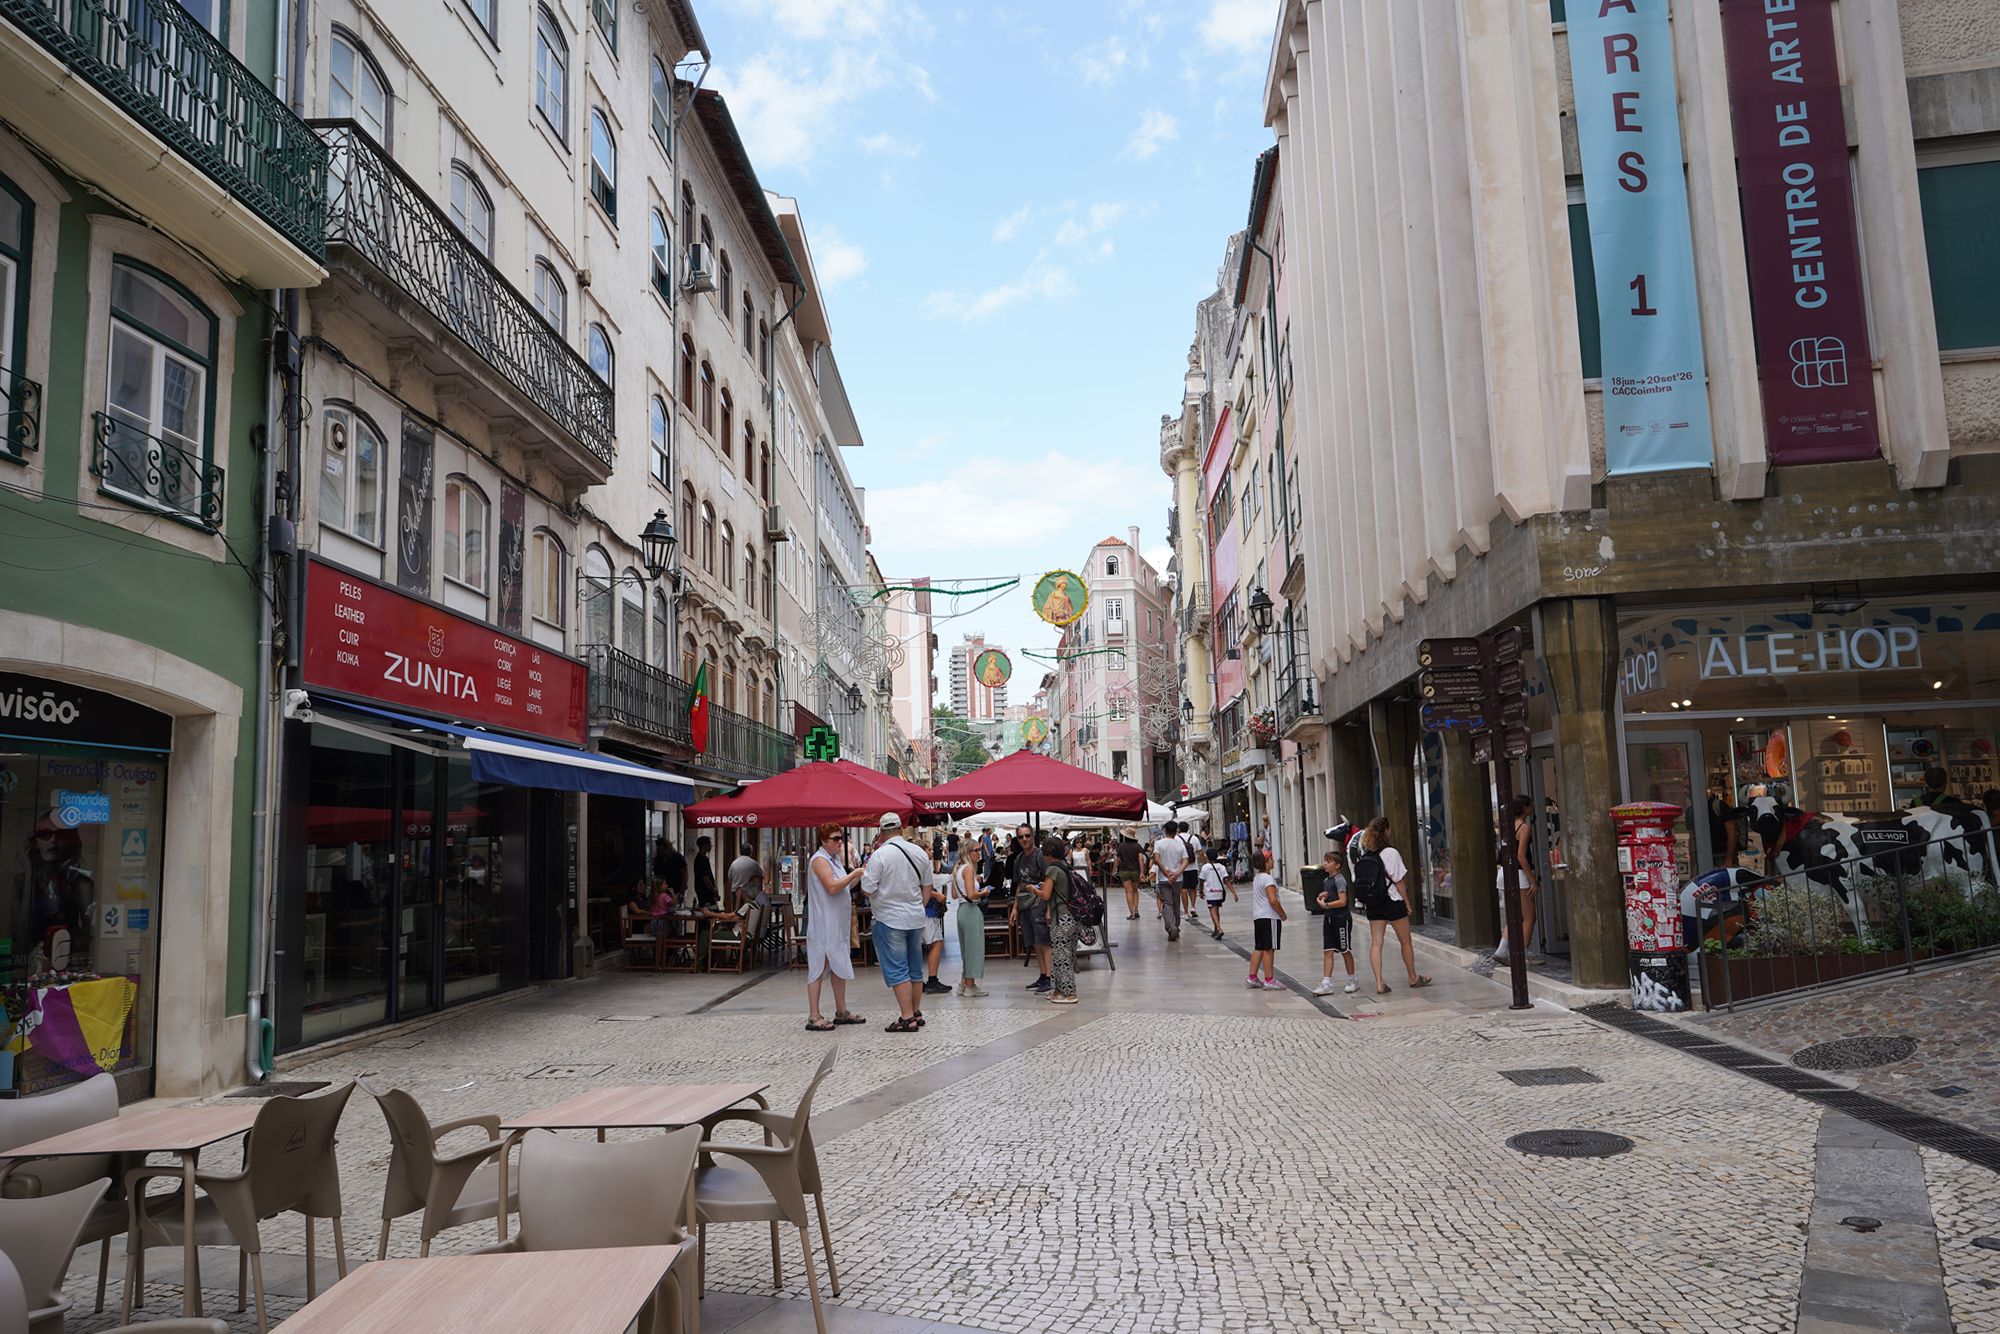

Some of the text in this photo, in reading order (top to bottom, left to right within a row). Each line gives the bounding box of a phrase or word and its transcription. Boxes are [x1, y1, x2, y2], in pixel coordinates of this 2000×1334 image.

[1765, 0, 1828, 309] CENTRO DE ARTE
[1629, 274, 1657, 316] 1
[1612, 385, 1672, 396] CACCoimbra
[339, 581, 362, 600] PELES
[334, 603, 365, 625] LEATHER
[339, 629, 360, 646] CUIR
[494, 639, 517, 657] CORTIÇA
[1702, 626, 1919, 678] ALE-HOP
[336, 650, 360, 667] КОЖА
[497, 659, 512, 673] CORK
[383, 651, 479, 703] ZUNITA
[528, 669, 543, 683] WOOL
[528, 687, 542, 700] LAINE
[113, 764, 157, 783] Oculista
[60, 791, 110, 807] Fernandes
[925, 801, 972, 810] SUPER BOCK
[696, 816, 721, 825] SUPER
[722, 815, 744, 824] BOCK
[1865, 831, 1905, 842] ALE-HOP
